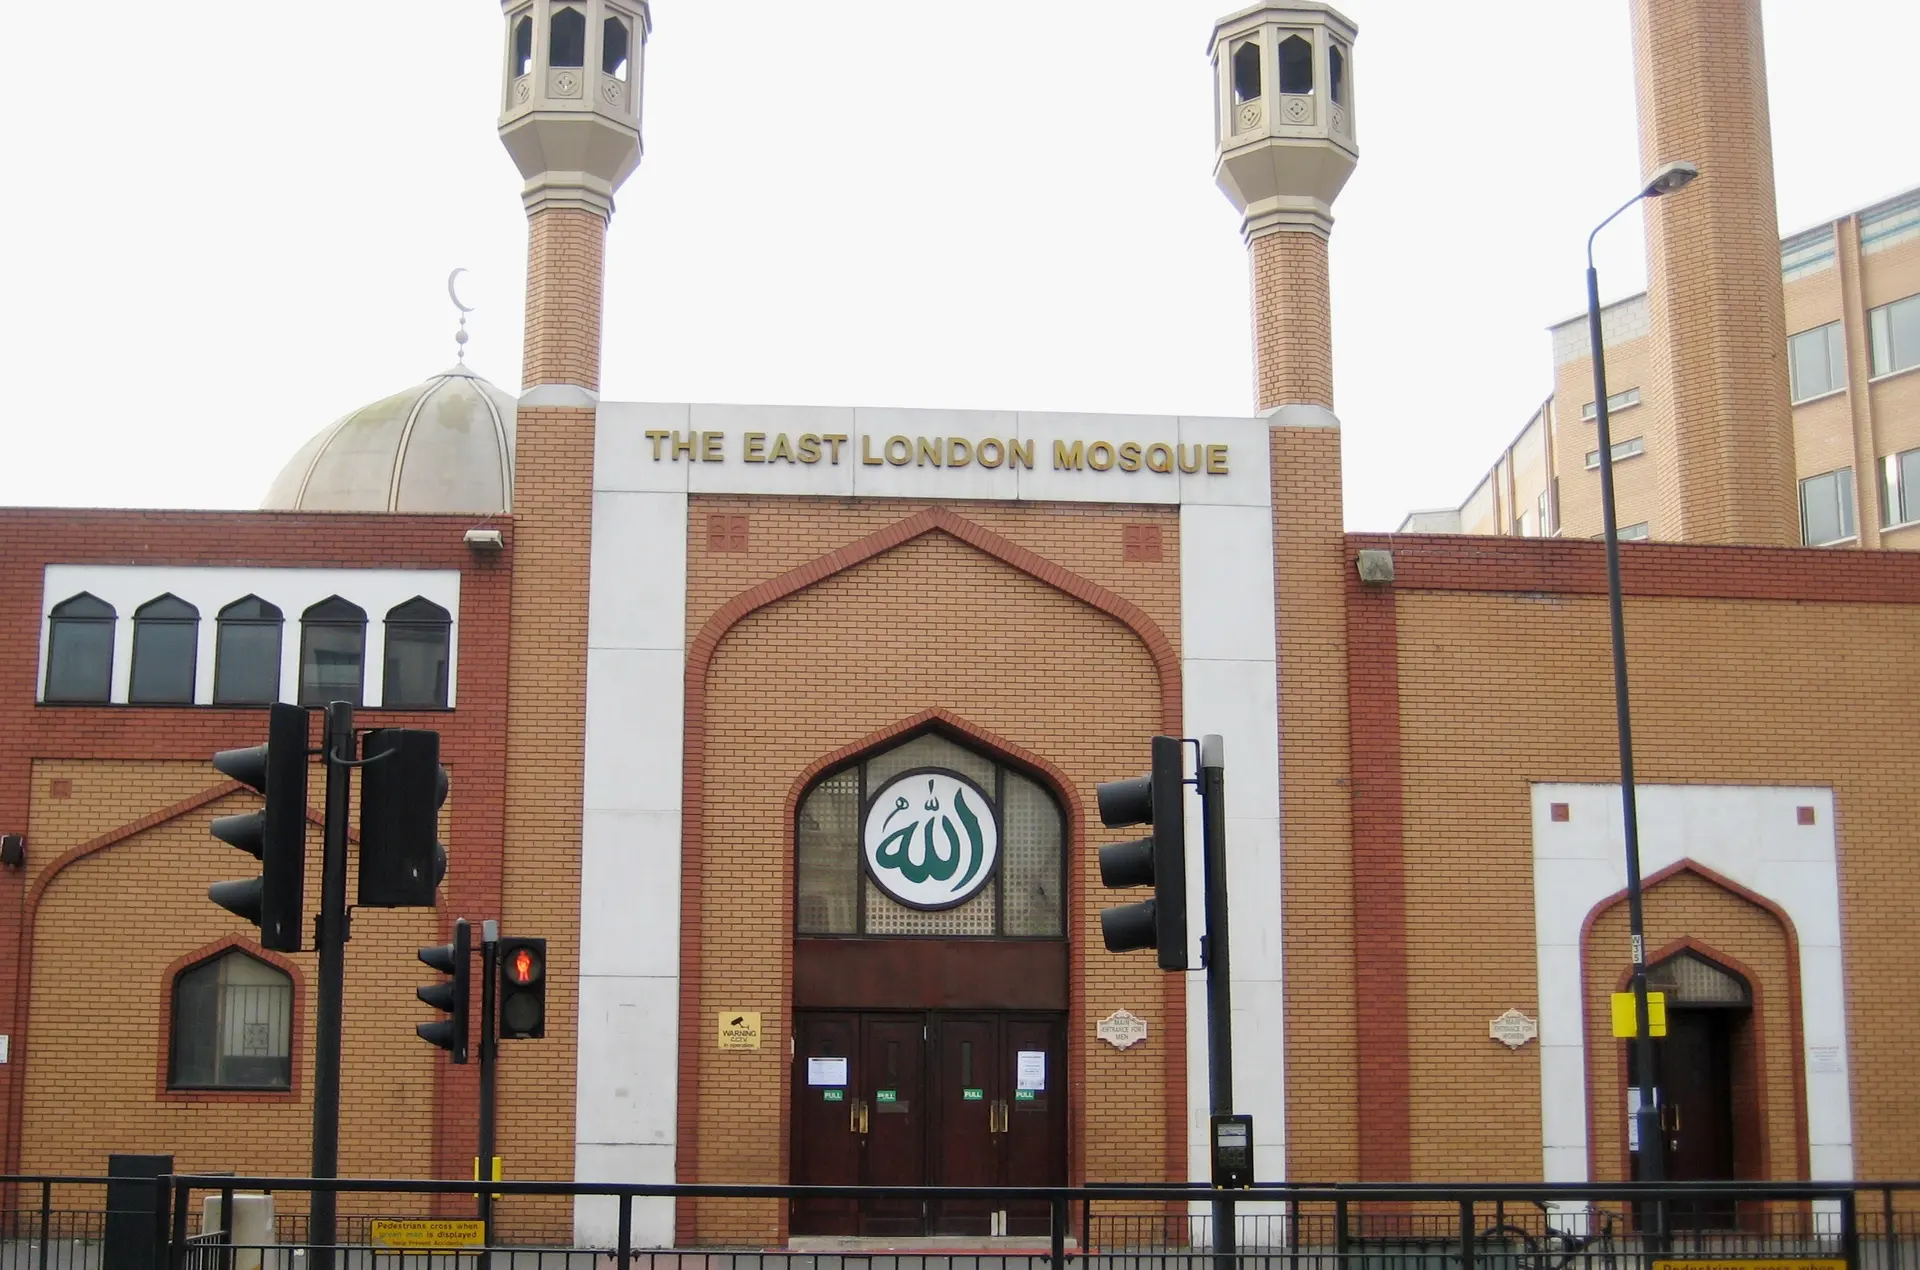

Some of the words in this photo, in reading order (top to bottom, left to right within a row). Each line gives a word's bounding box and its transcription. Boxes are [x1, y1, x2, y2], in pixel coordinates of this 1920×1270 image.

[645, 430, 724, 461] THE
[743, 432, 848, 464] EAST
[862, 434, 1034, 469] LONDON
[1053, 439, 1229, 474] MOSQUE
[877, 1092, 896, 1100] PULL
[964, 1090, 982, 1099] PULL
[1015, 1090, 1034, 1099] PULL
[377, 1222, 427, 1230] Pedestrians
[456, 1222, 479, 1230] when
[426, 1230, 434, 1238] is
[437, 1230, 478, 1239] displayed
